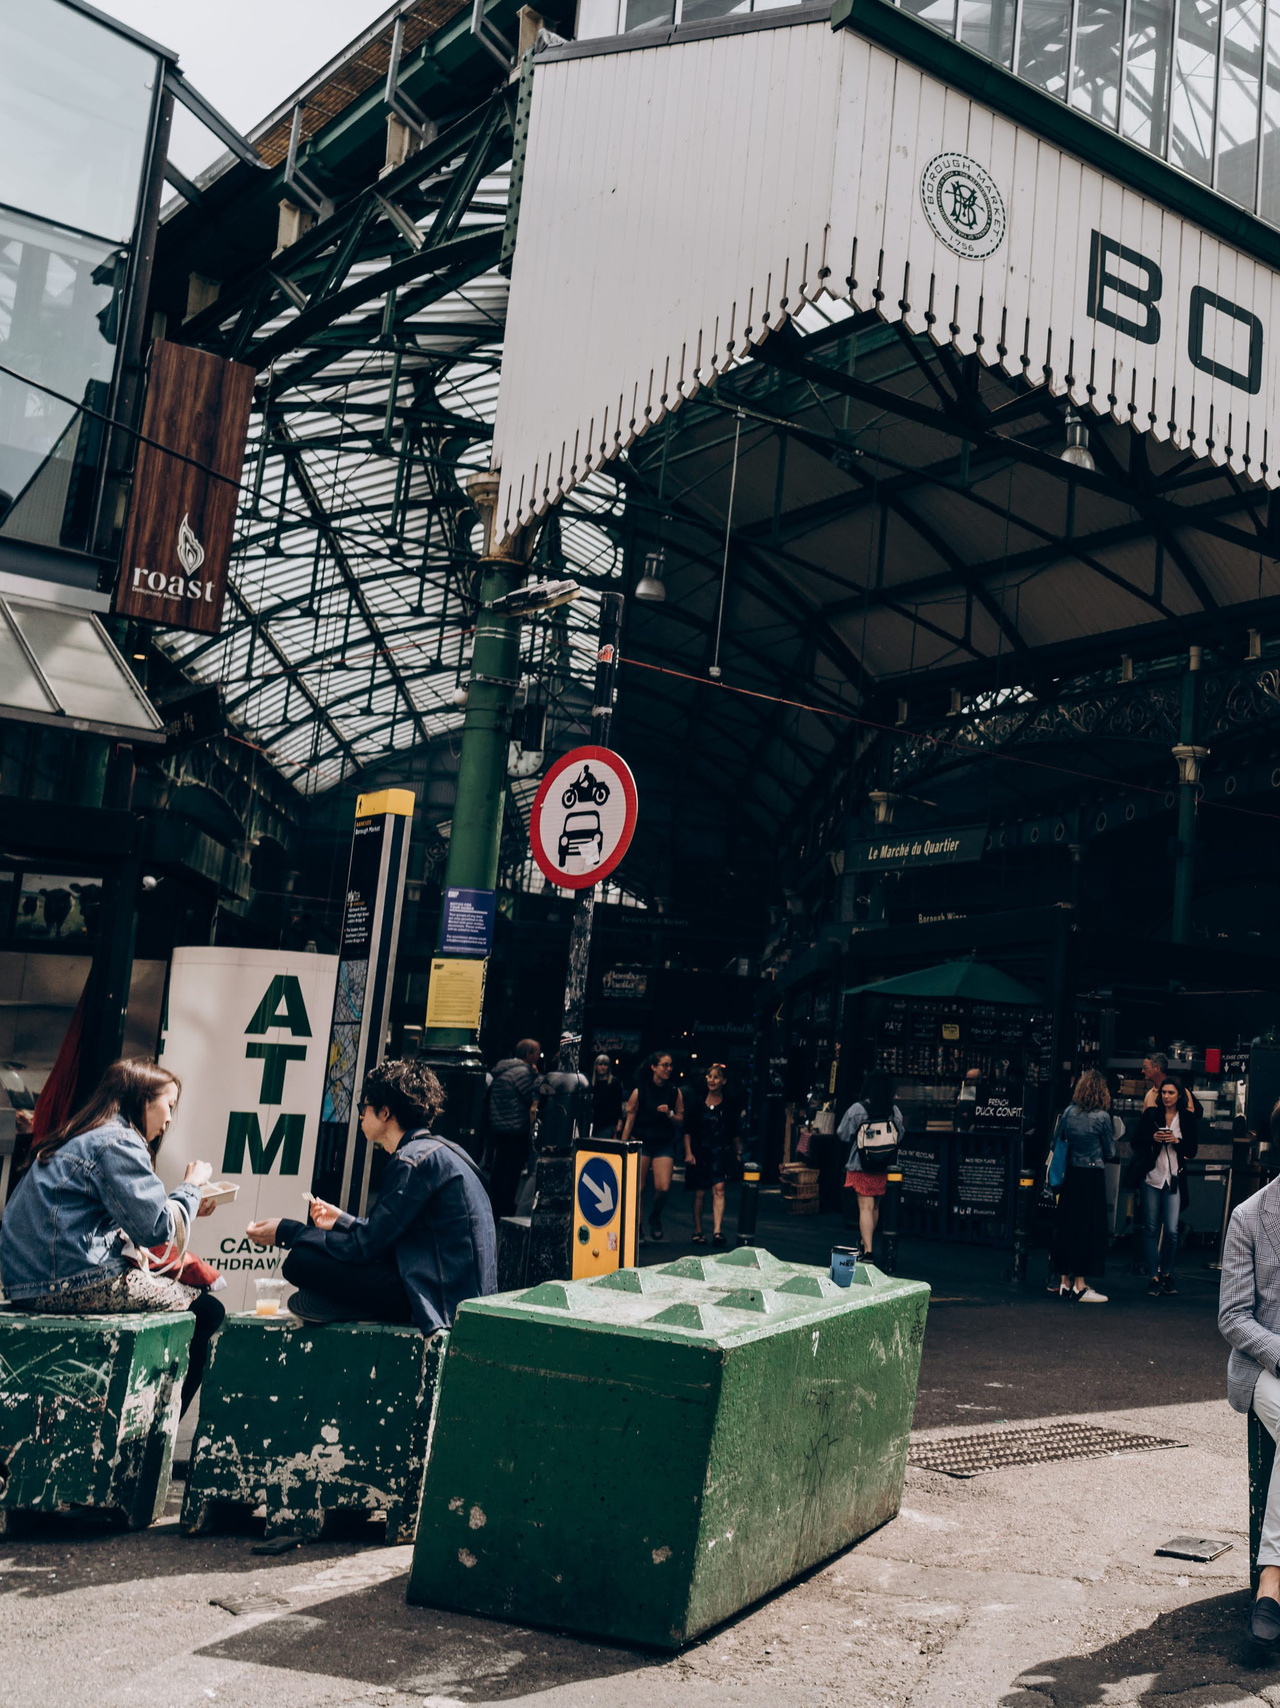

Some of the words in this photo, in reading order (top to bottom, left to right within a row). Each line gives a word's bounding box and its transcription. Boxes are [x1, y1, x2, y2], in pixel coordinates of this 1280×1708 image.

[926, 159, 971, 205] BOROUGH
[976, 172, 1001, 238] MARKET
[949, 234, 975, 252] 1756
[133, 567, 215, 602] roast
[868, 846, 878, 860] Le
[879, 842, 910, 858] Marché
[911, 842, 921, 855] du
[923, 838, 961, 857] Quartier
[222, 974, 312, 1176] ATM
[975, 1106, 995, 1117] DUCK
[996, 1106, 1023, 1118] CONFIT
[988, 1097, 1009, 1107] FRENCH
